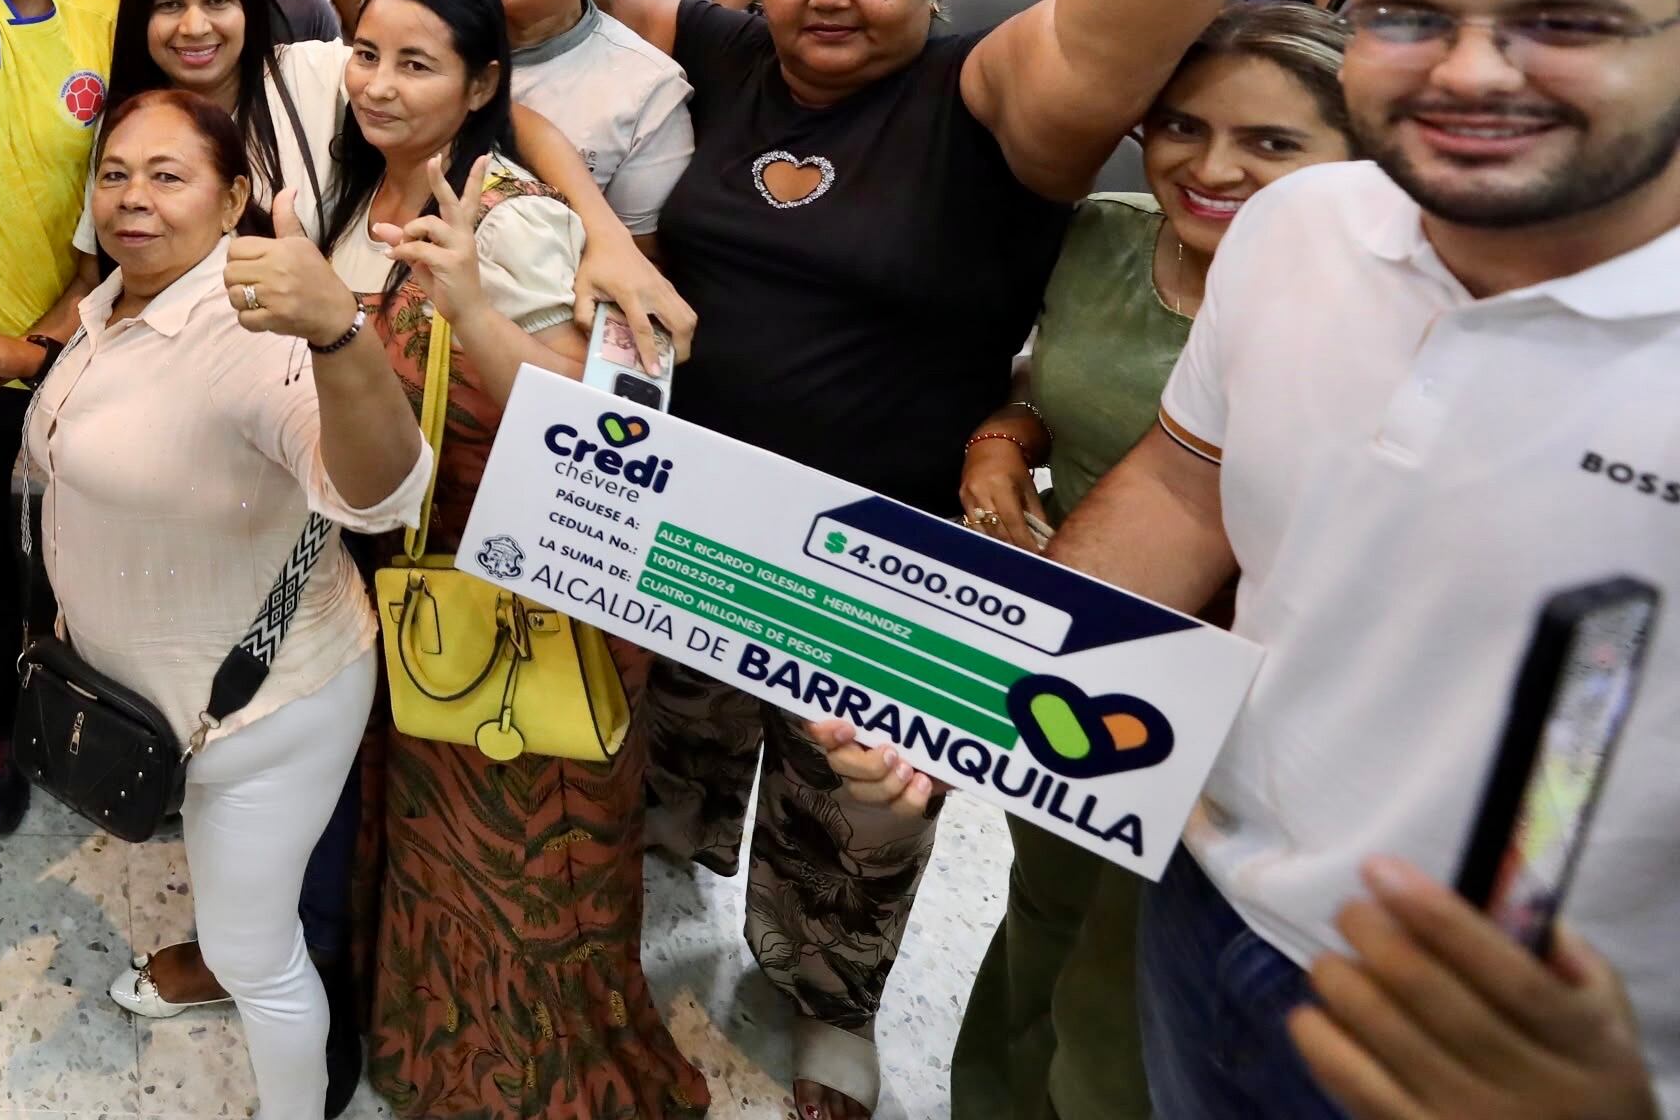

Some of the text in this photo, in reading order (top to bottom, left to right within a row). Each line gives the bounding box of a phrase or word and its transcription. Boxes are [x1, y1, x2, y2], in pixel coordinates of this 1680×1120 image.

[544, 424, 674, 494] Credi
[555, 460, 640, 503] chévere
[1580, 450, 1680, 505] BOSS
[549, 512, 604, 541] CEDULA
[556, 488, 640, 530] PÁGUESE A:
[539, 536, 632, 582] LA SUMA DE:
[652, 551, 735, 594] 1001825024
[658, 529, 913, 640] ALEX RICARDO IGLESIAS HERNANDEZ
[641, 576, 833, 664] CUATRO MILLONES DE PESOS
[531, 564, 1144, 857] ALCALDÍA DE BARRANQUILLA
